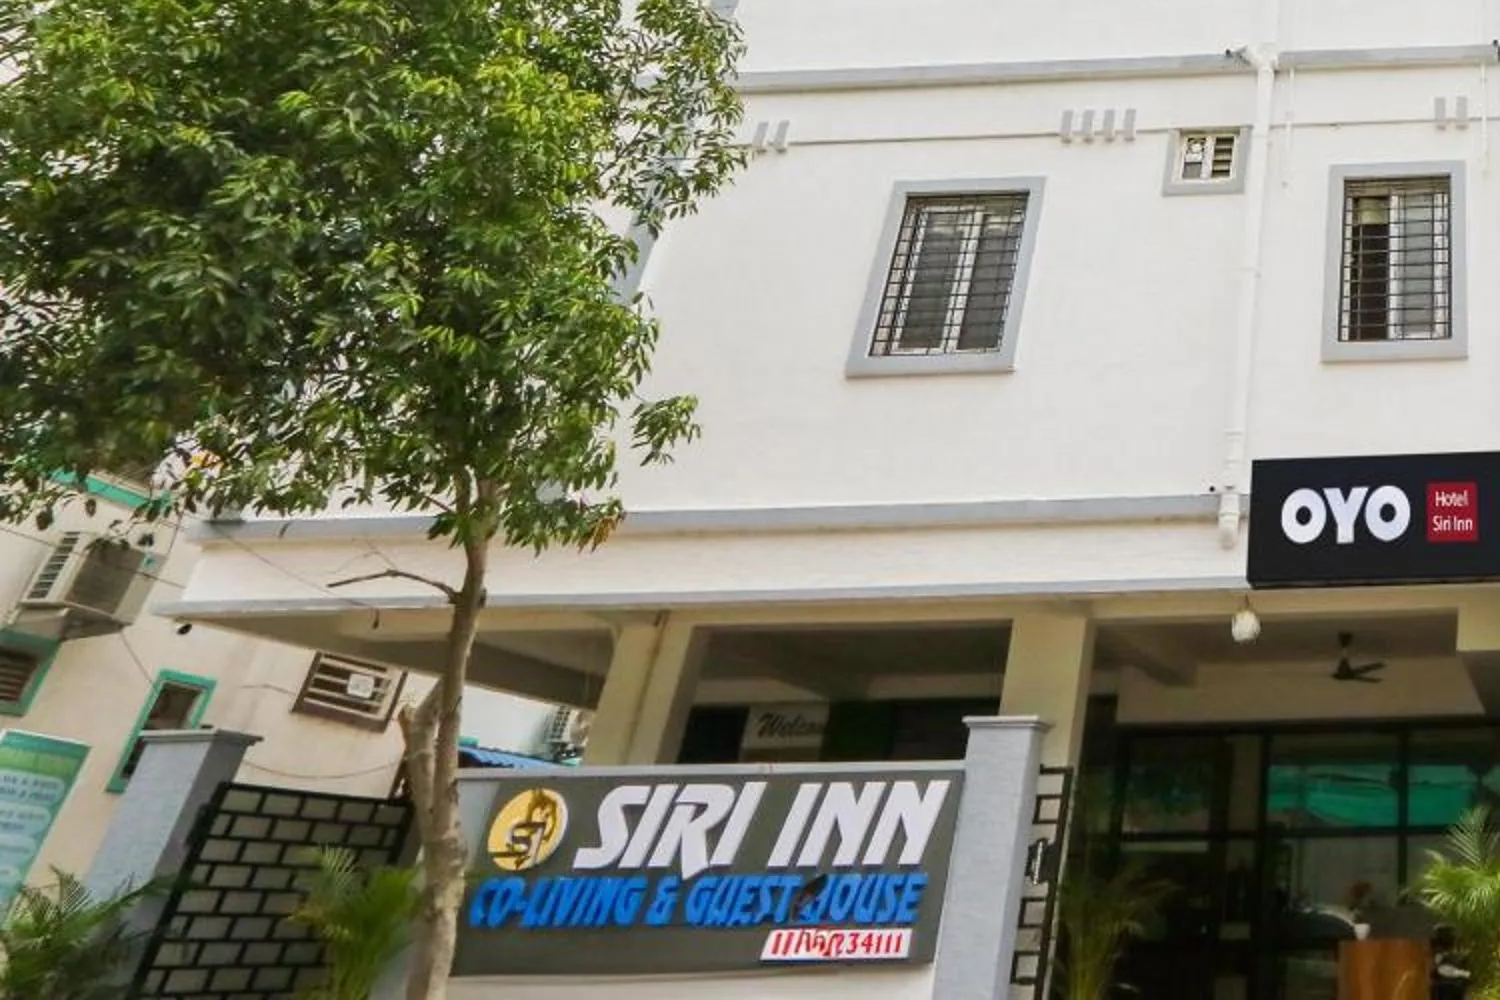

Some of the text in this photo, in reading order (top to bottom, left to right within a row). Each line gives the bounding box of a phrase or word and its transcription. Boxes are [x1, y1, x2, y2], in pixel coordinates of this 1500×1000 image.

[1281, 485, 1411, 544] OYO
[1433, 515, 1473, 531] Siri Inn
[1435, 490, 1469, 507] Hotel
[573, 780, 950, 880] SIRI INN
[468, 874, 648, 928] CO-LIVING
[644, 874, 680, 928] &
[685, 873, 804, 926] GUEST
